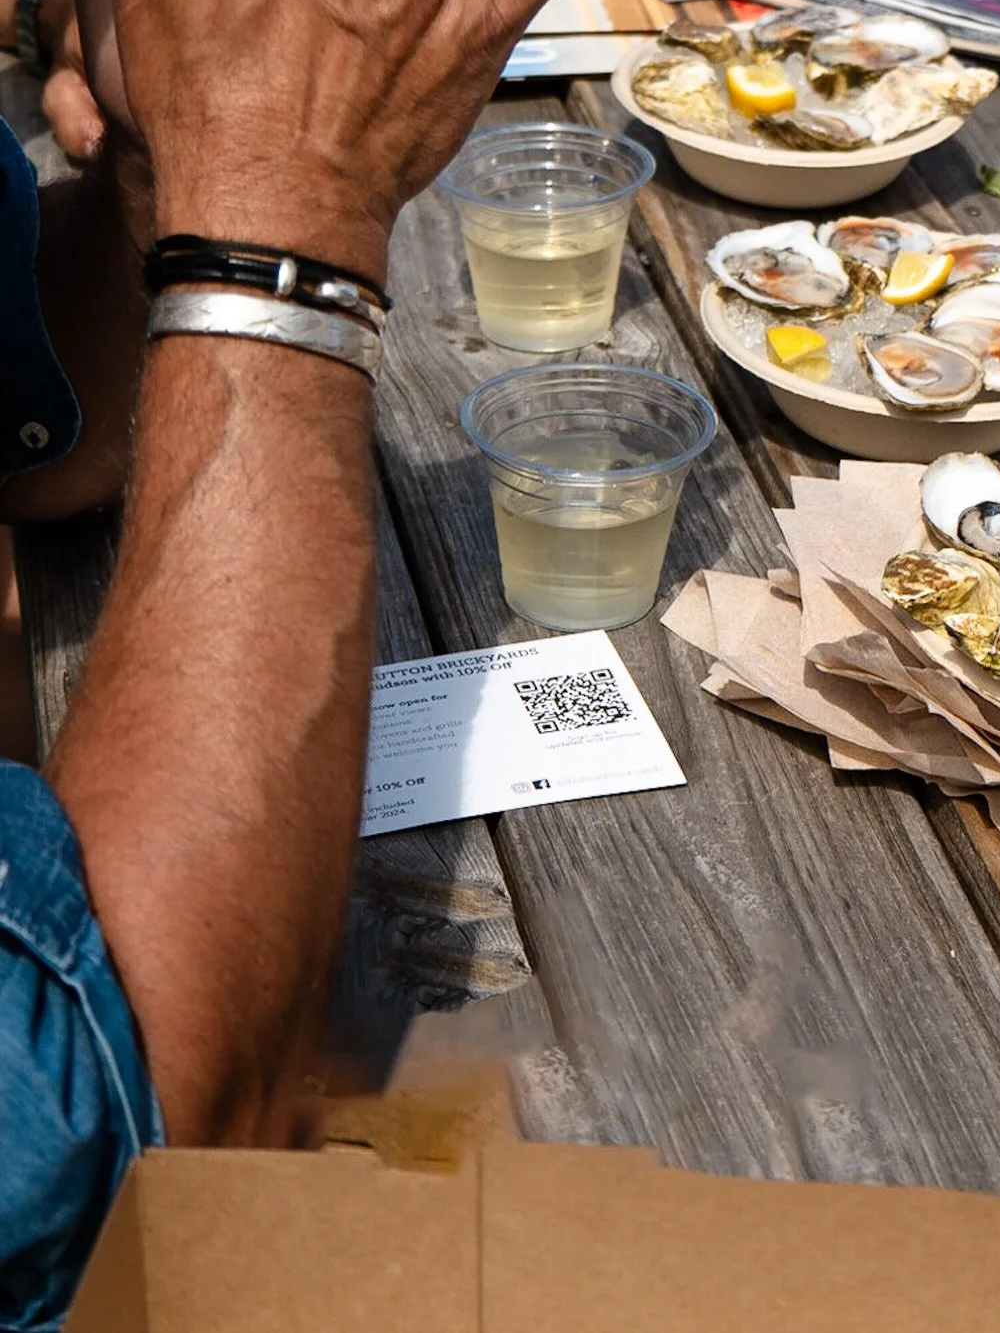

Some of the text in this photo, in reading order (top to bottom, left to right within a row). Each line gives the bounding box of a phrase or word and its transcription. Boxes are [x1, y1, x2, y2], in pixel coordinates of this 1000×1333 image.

[373, 647, 539, 681] UTTON BRICKYARDS
[374, 661, 513, 691] udson with 10% Off
[398, 697, 429, 708] open
[430, 693, 449, 702] for
[375, 780, 403, 793] 10%
[405, 776, 426, 787] Off
[379, 807, 406, 819] 2024
